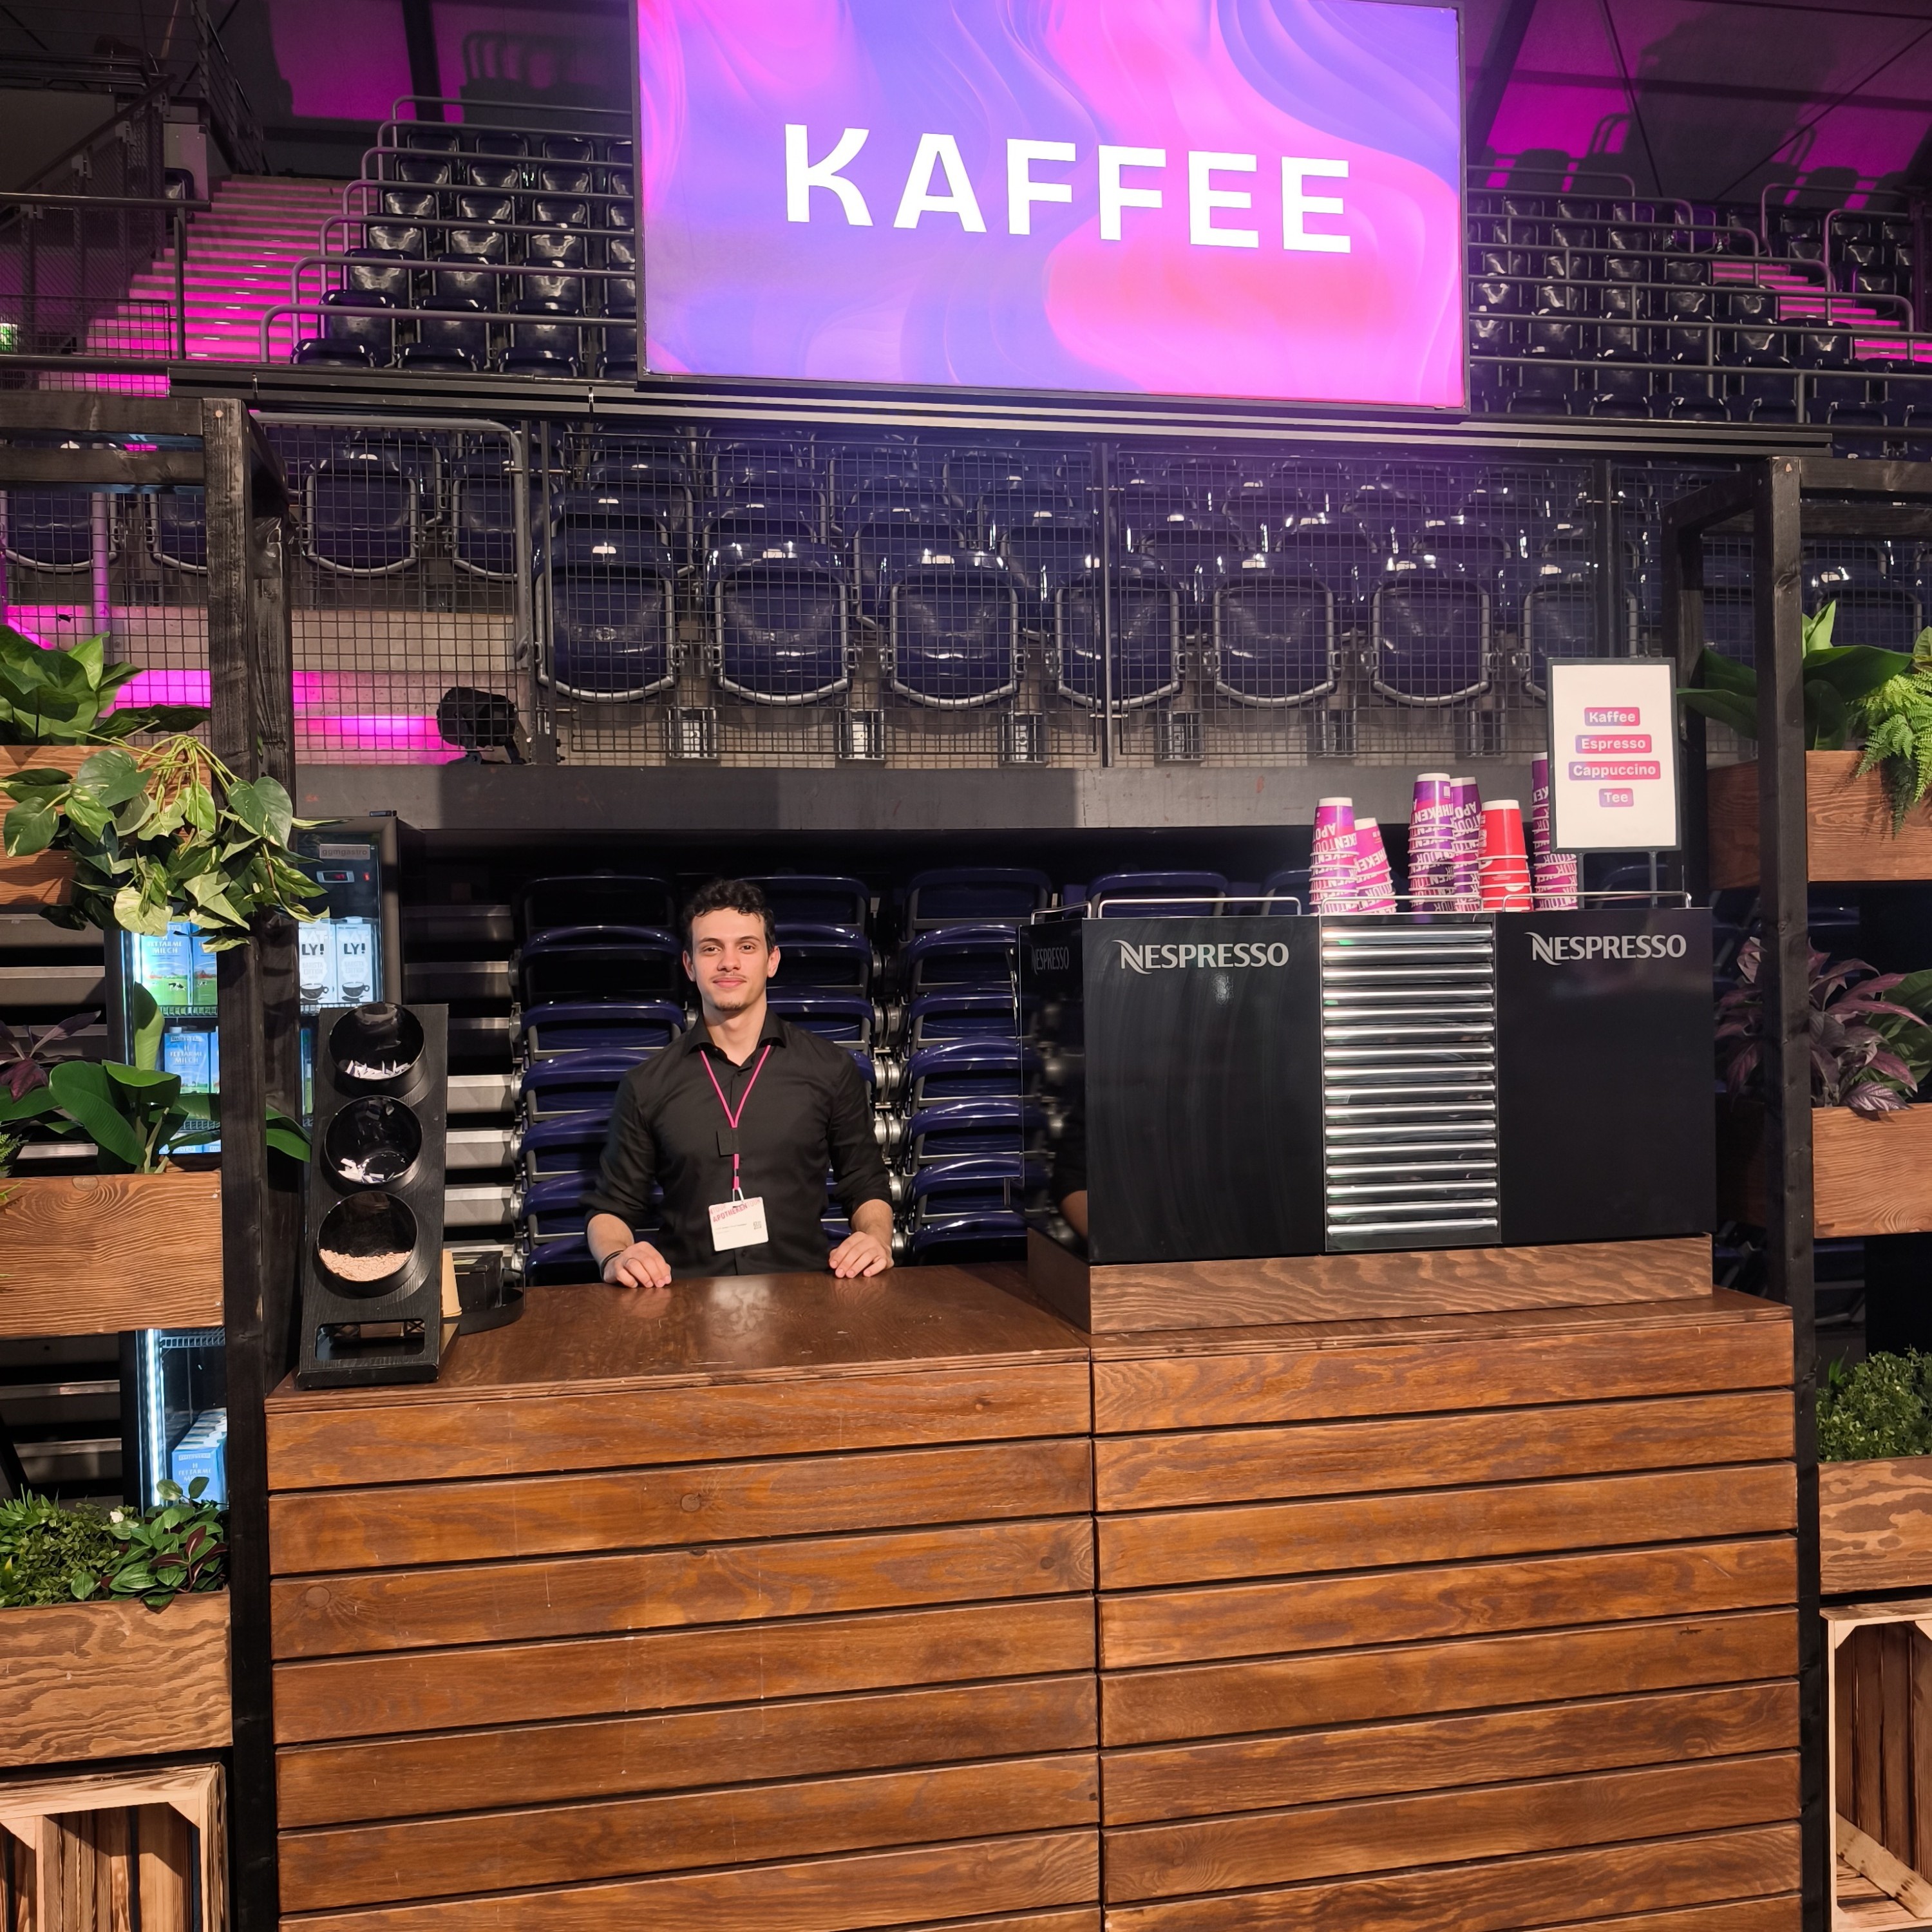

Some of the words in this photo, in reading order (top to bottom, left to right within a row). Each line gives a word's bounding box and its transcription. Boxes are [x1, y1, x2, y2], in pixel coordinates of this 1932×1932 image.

[785, 124, 1350, 253] KAFFEE
[1589, 710, 1636, 723] Kaffee
[1581, 739, 1646, 752] Espresso
[1573, 764, 1656, 778] Cappuccino
[1604, 792, 1629, 802] Tee
[301, 943, 325, 956] LY!
[343, 943, 365, 955] LY!
[1524, 932, 1687, 965] NESPRESSO
[1030, 945, 1069, 975] NESPRESSO
[1112, 940, 1289, 974] NESPRESSO
